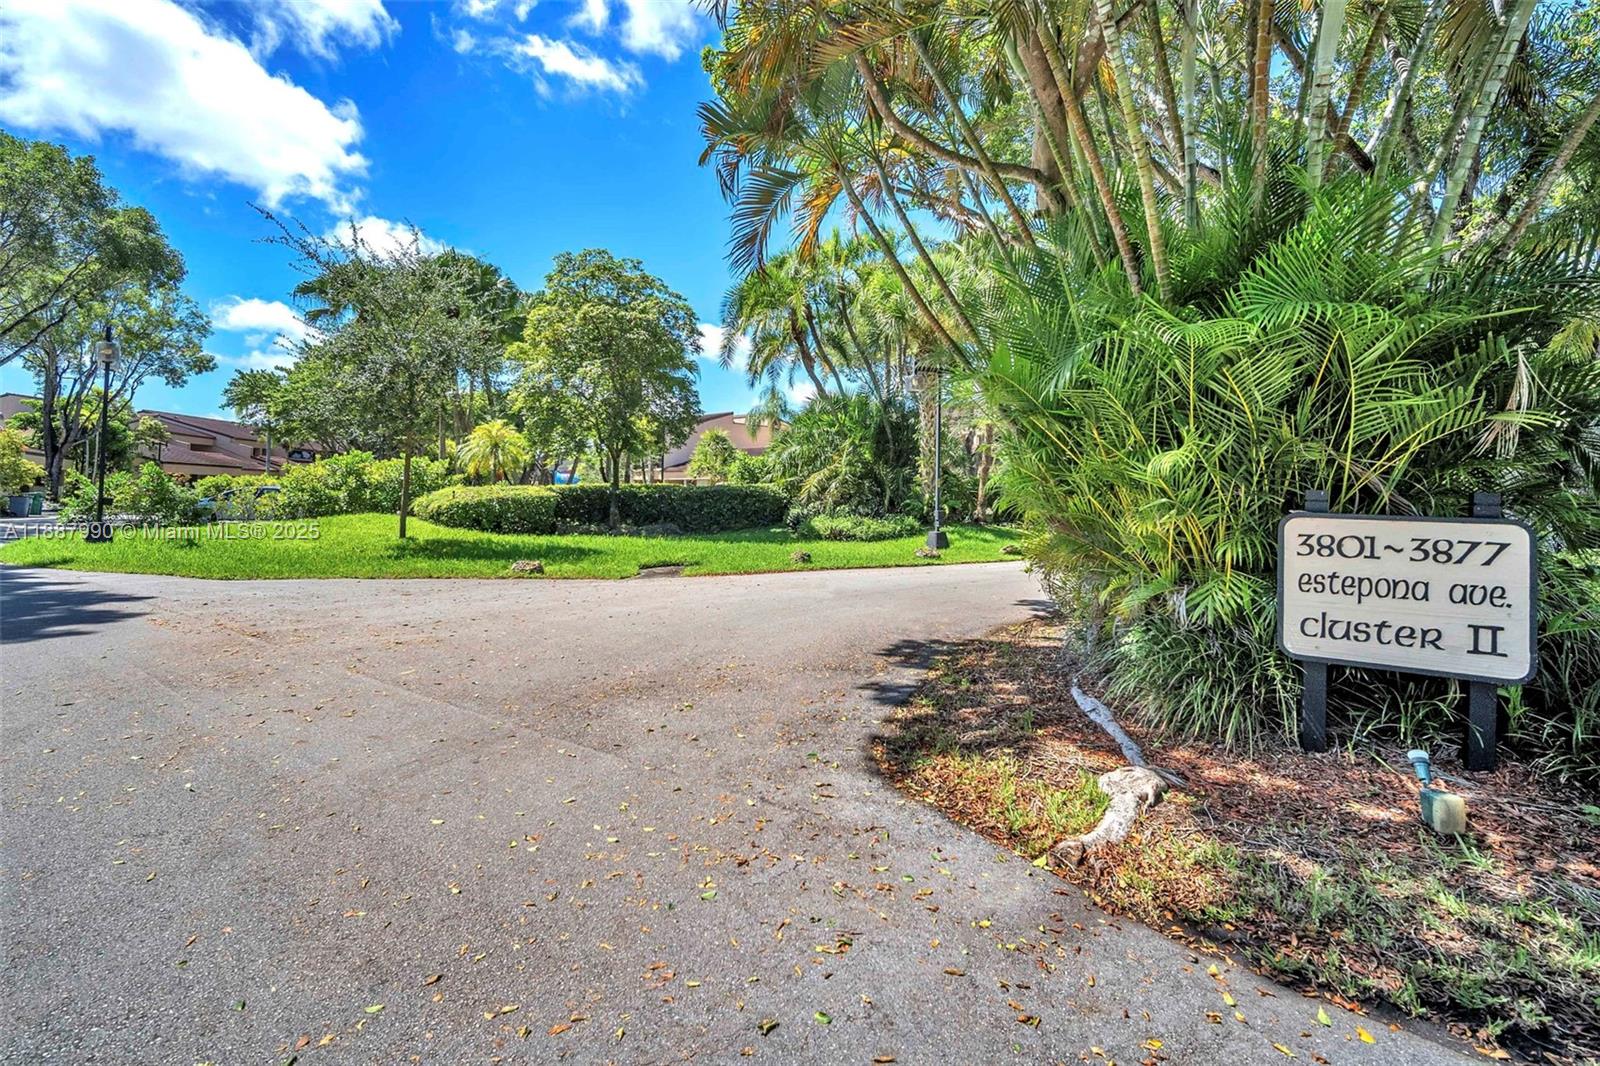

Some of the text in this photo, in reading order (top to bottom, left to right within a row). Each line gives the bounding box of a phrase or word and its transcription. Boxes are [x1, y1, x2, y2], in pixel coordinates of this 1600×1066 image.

[1298, 572, 1512, 608] estepona ave.
[1466, 624, 1508, 657] II
